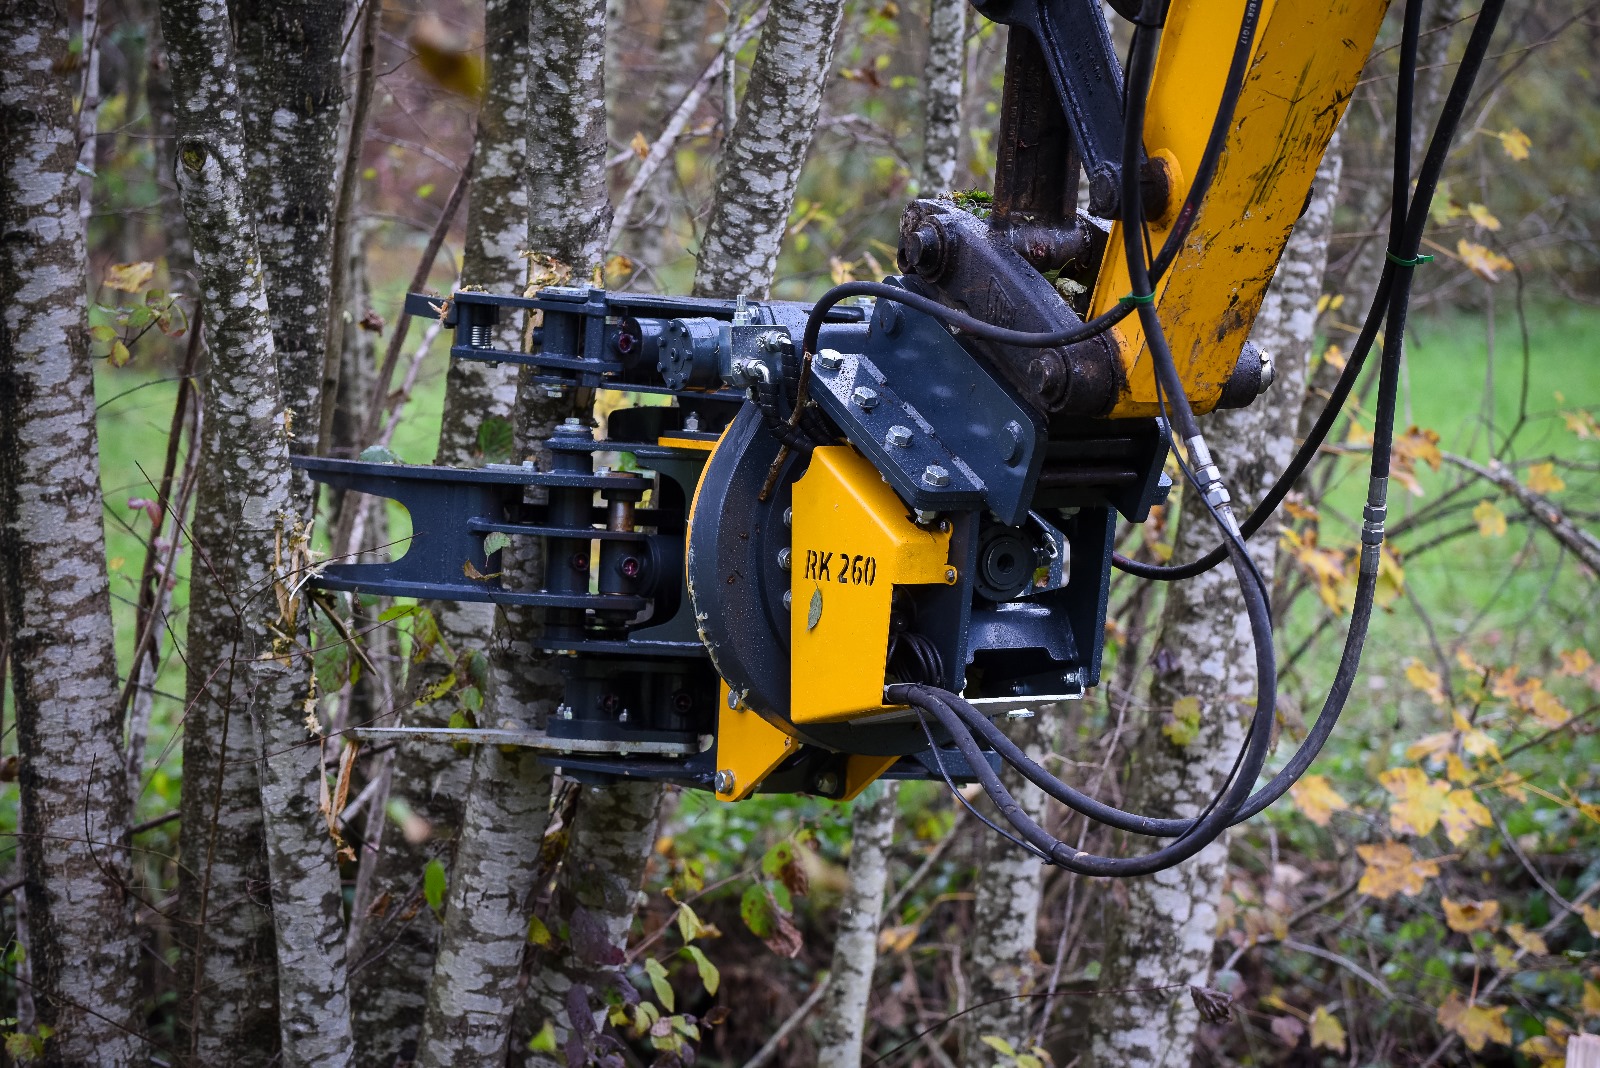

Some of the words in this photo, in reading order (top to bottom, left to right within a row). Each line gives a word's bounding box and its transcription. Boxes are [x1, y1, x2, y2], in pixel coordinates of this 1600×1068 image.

[1247, 2, 1257, 18] BAR
[804, 549, 834, 582] RK
[837, 553, 877, 587] 260
